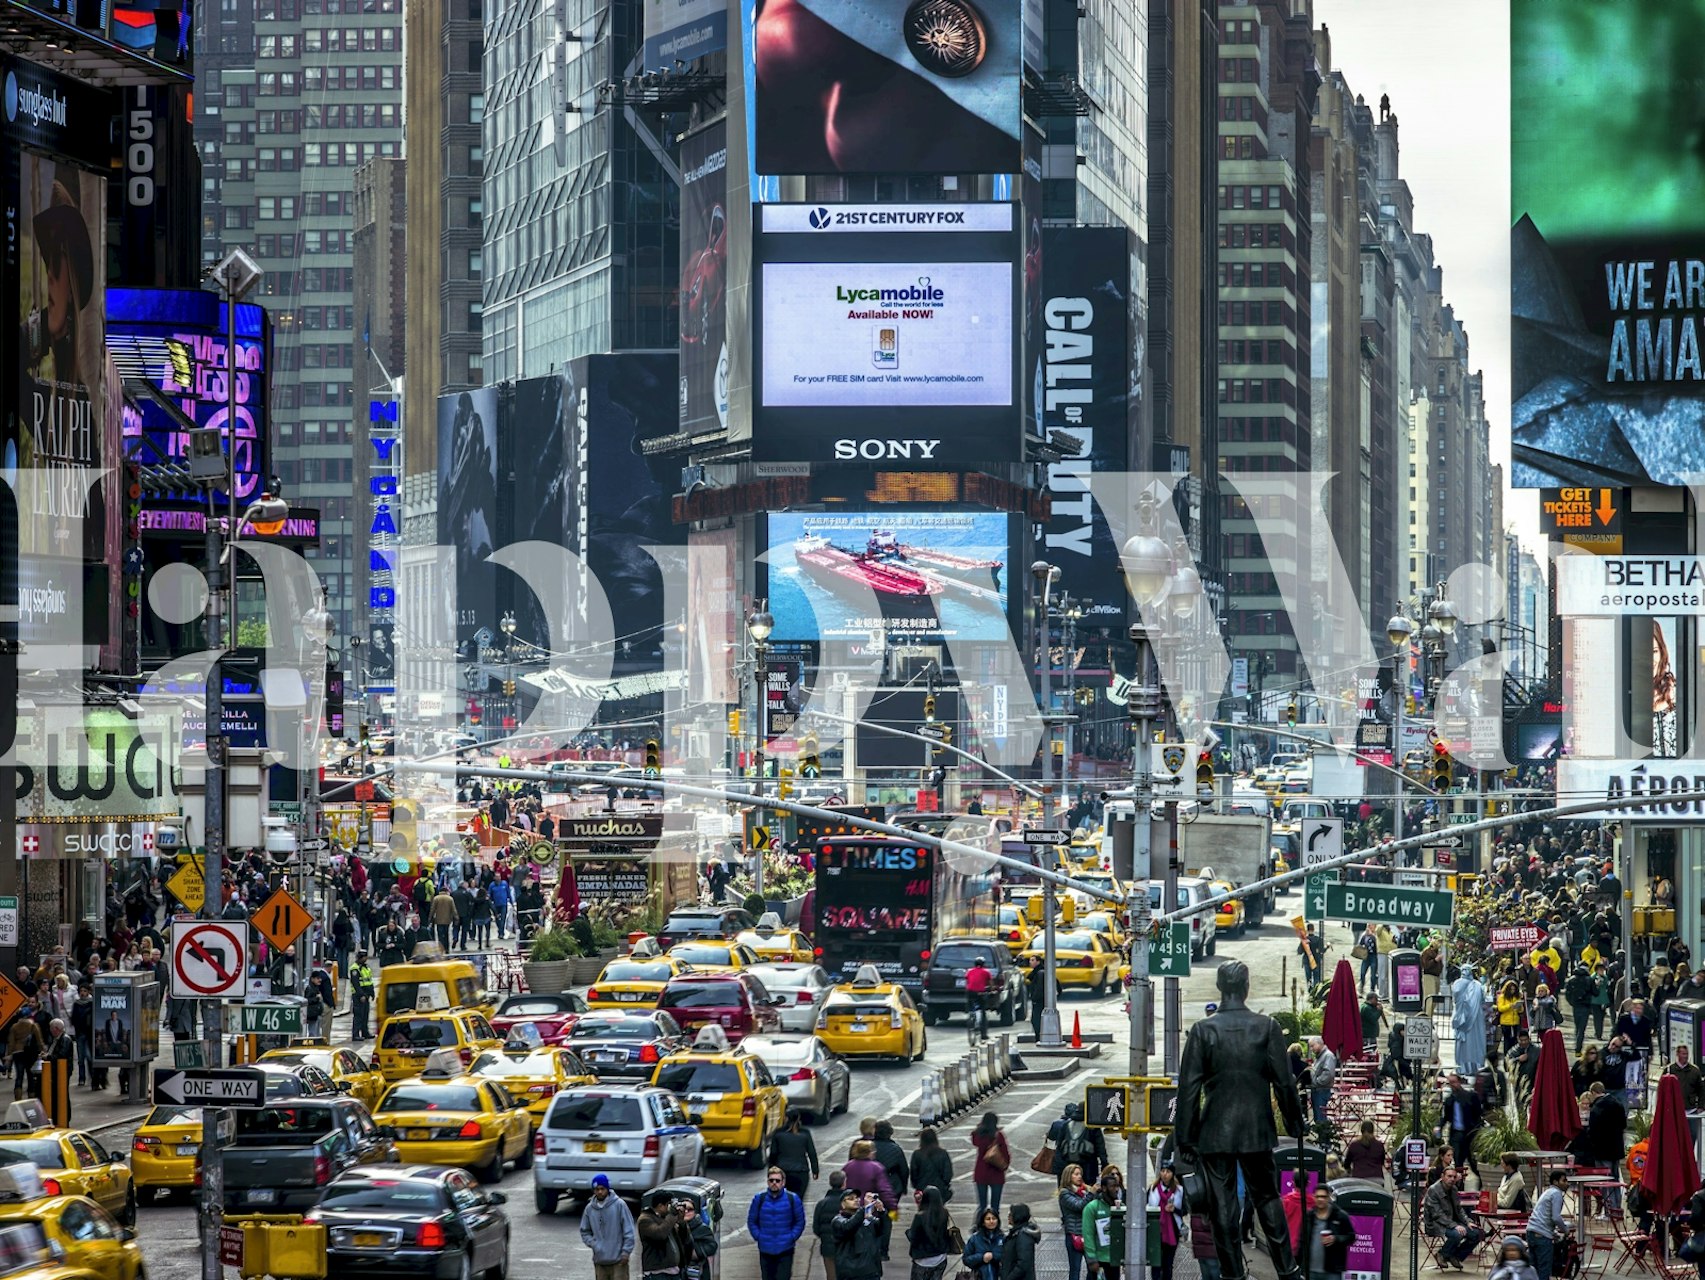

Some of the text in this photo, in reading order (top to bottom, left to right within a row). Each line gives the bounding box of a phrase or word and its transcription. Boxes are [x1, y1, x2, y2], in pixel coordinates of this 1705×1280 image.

[18, 84, 67, 128] sunglass hut
[836, 212, 965, 225] 21ST CENTURY FOX
[1604, 261, 1655, 311] WE
[836, 285, 944, 304] Lycamobile
[847, 309, 934, 320] Available NOW!
[793, 374, 984, 385] For your FREE SIM card Visit www.lycamobile.com
[33, 392, 92, 461] RALPH
[1044, 296, 1093, 557] CALL OF DUTY
[834, 439, 940, 459] SONY
[757, 464, 808, 474] SHERWOOD
[33, 457, 92, 519] LAUREN
[1559, 488, 1592, 502] GET
[1544, 501, 1592, 514] TICKETS
[1556, 513, 1592, 527] HERE
[1567, 534, 1617, 543] COMPANY
[768, 672, 788, 682] SOME
[1359, 679, 1379, 688] SOME
[768, 681, 791, 692] WALLS
[1359, 689, 1383, 699] WALLS
[768, 700, 785, 710] TALK
[1359, 709, 1377, 719] TALK
[1450, 815, 1471, 824] W 45
[573, 819, 646, 836] nuchas
[64, 833, 143, 853] swatch
[158, 833, 176, 845] NYPD
[1030, 833, 1067, 842] ONE WAY
[841, 846, 916, 870] TIMES
[577, 881, 646, 890] EMPANADAS
[1344, 892, 1435, 923] Broadway
[822, 905, 928, 930] SQUARE
[1492, 927, 1538, 940] PRIVATE EYES
[1176, 943, 1187, 954] St
[100, 1000, 127, 1009] MAN
[246, 1008, 297, 1030] W 46 ST
[1409, 1047, 1427, 1055] BIKE
[183, 1080, 253, 1096] ONE WAY
